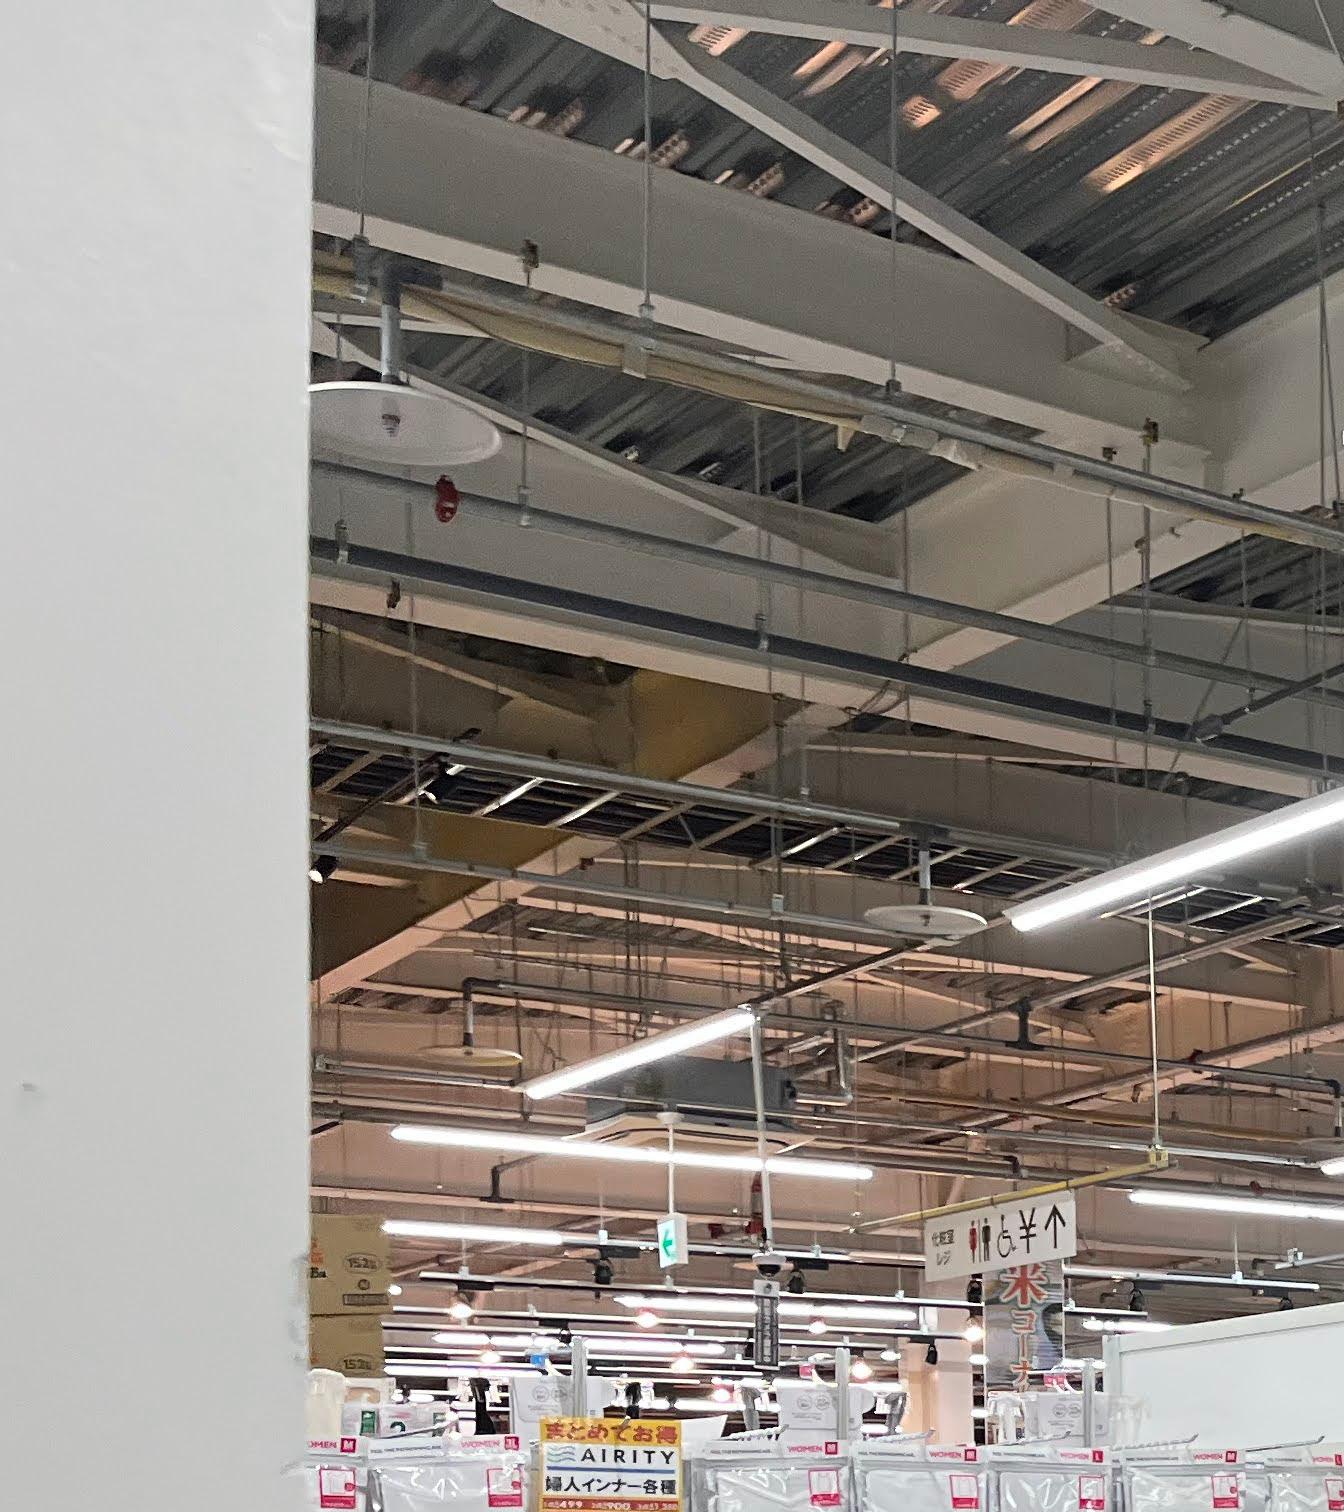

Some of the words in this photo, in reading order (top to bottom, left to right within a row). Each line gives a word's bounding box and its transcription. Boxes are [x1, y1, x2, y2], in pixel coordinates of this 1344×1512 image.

[581, 1448, 675, 1465] AIRITY
[545, 1476, 677, 1495] 婦人インナー各種
